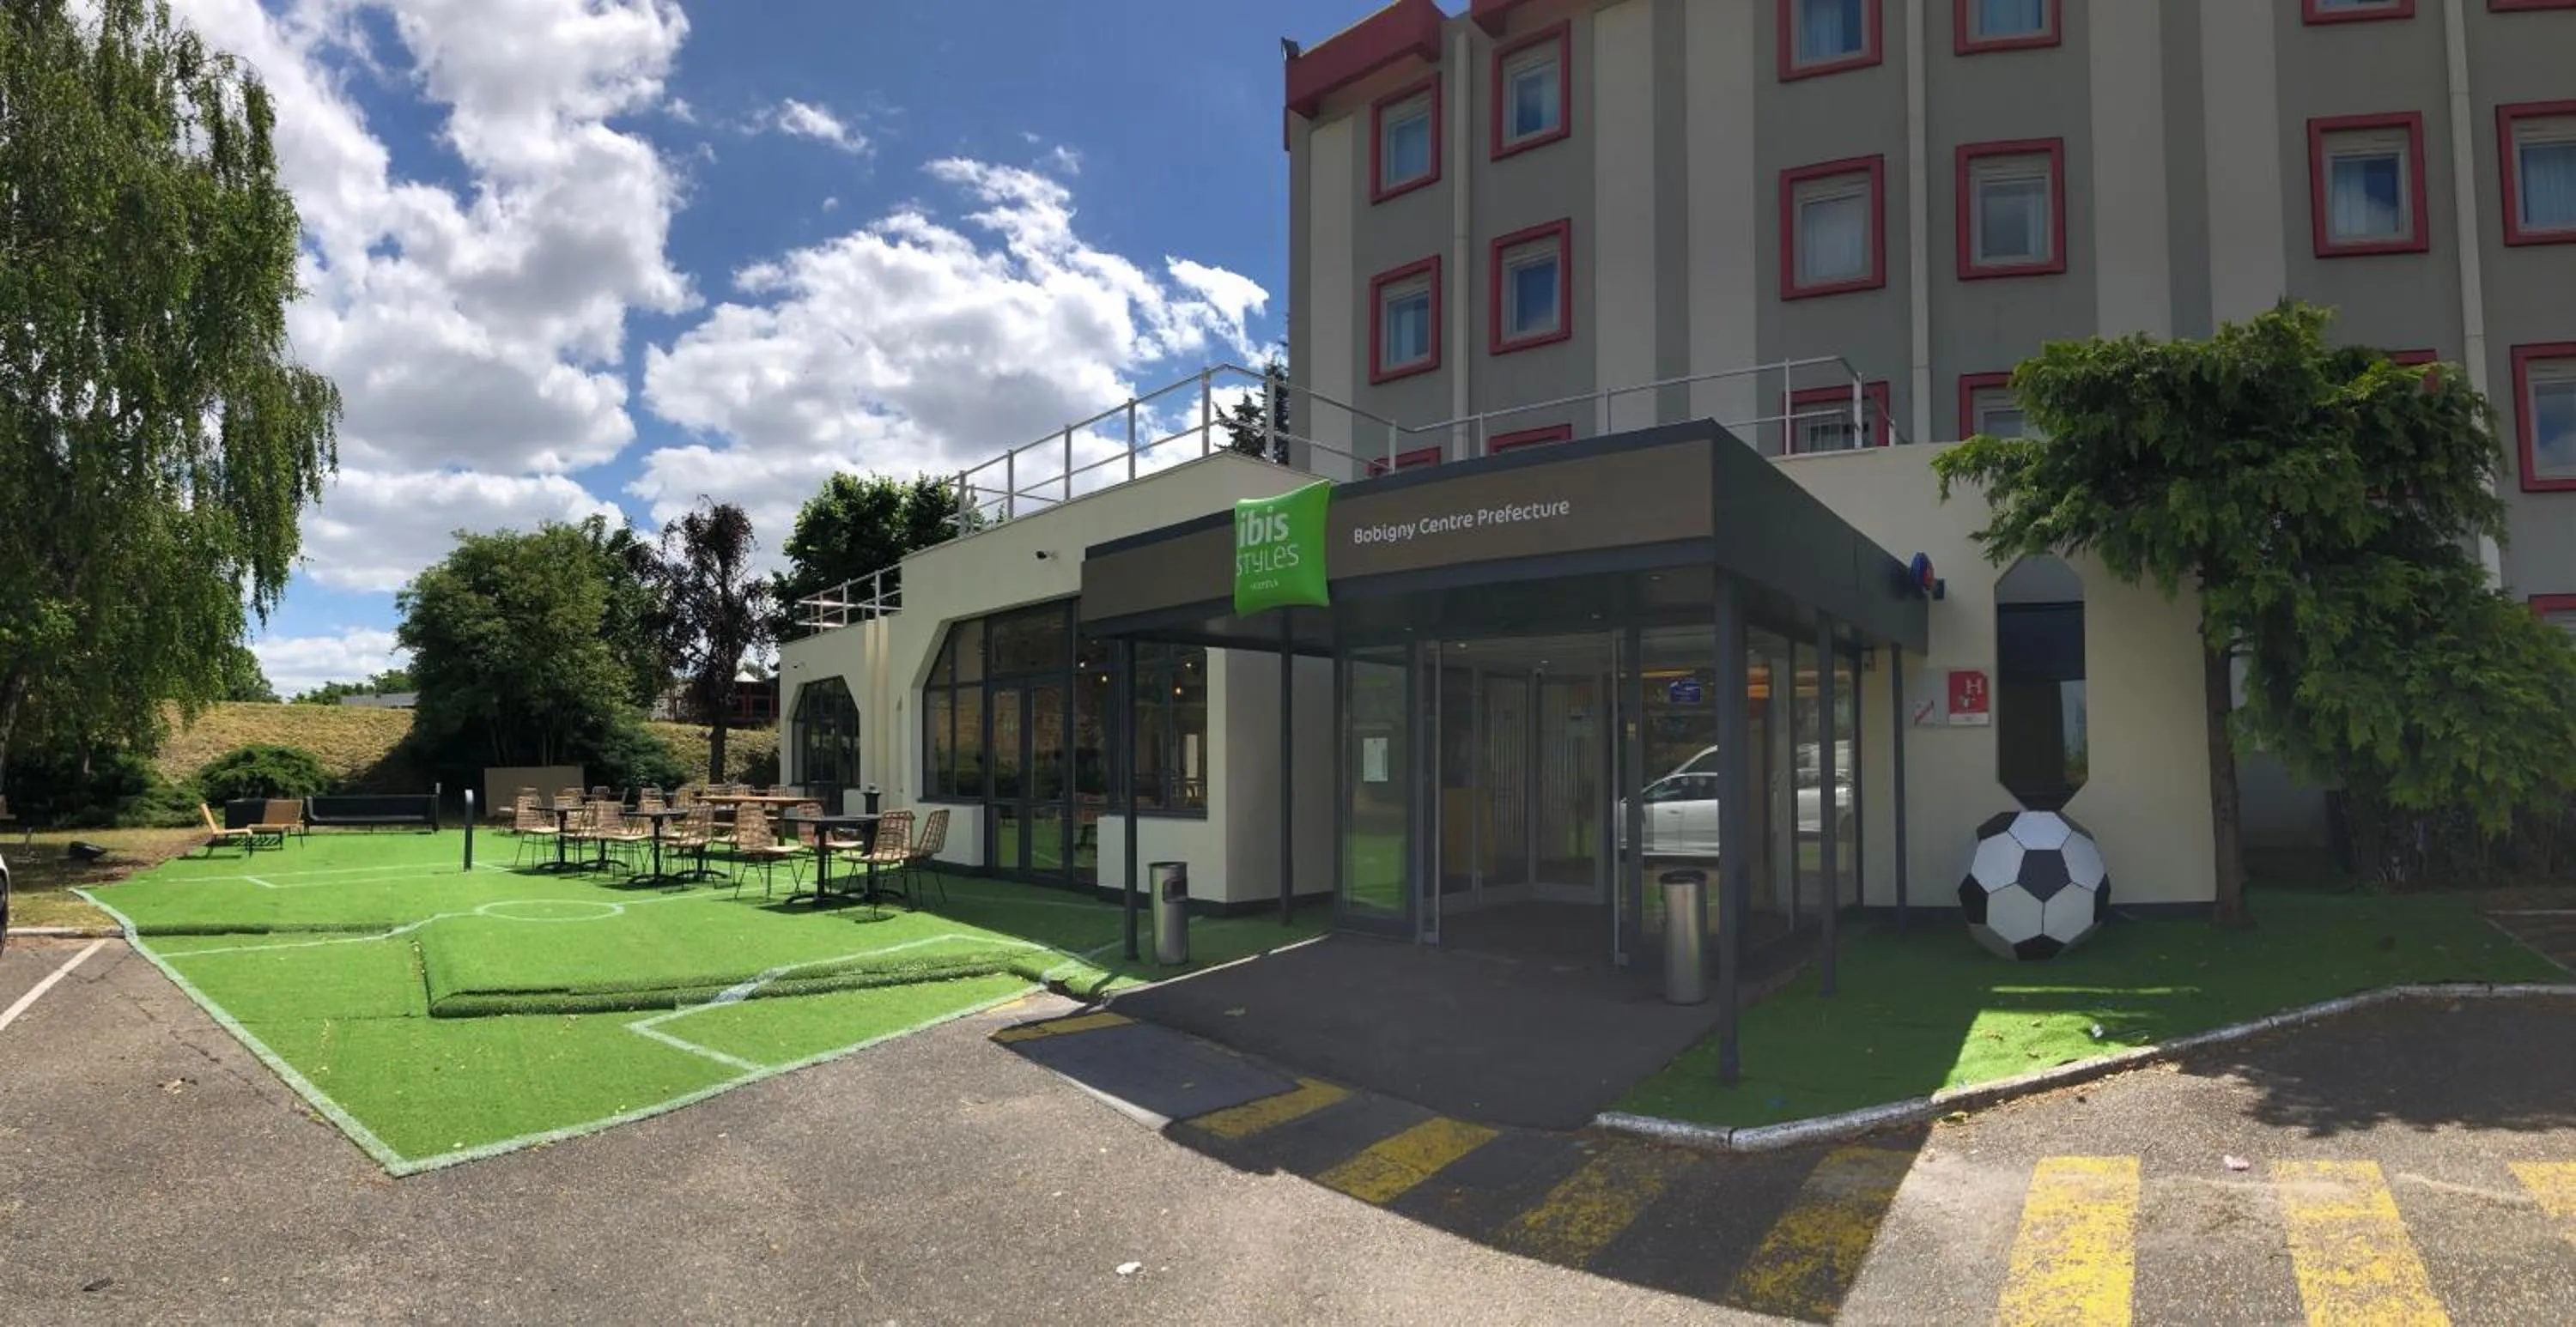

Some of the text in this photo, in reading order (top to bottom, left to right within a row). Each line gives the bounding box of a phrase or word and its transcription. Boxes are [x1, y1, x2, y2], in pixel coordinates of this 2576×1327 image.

[1239, 506, 1290, 547] ibis
[1354, 500, 1571, 544] Bobigny Centre Prefecture
